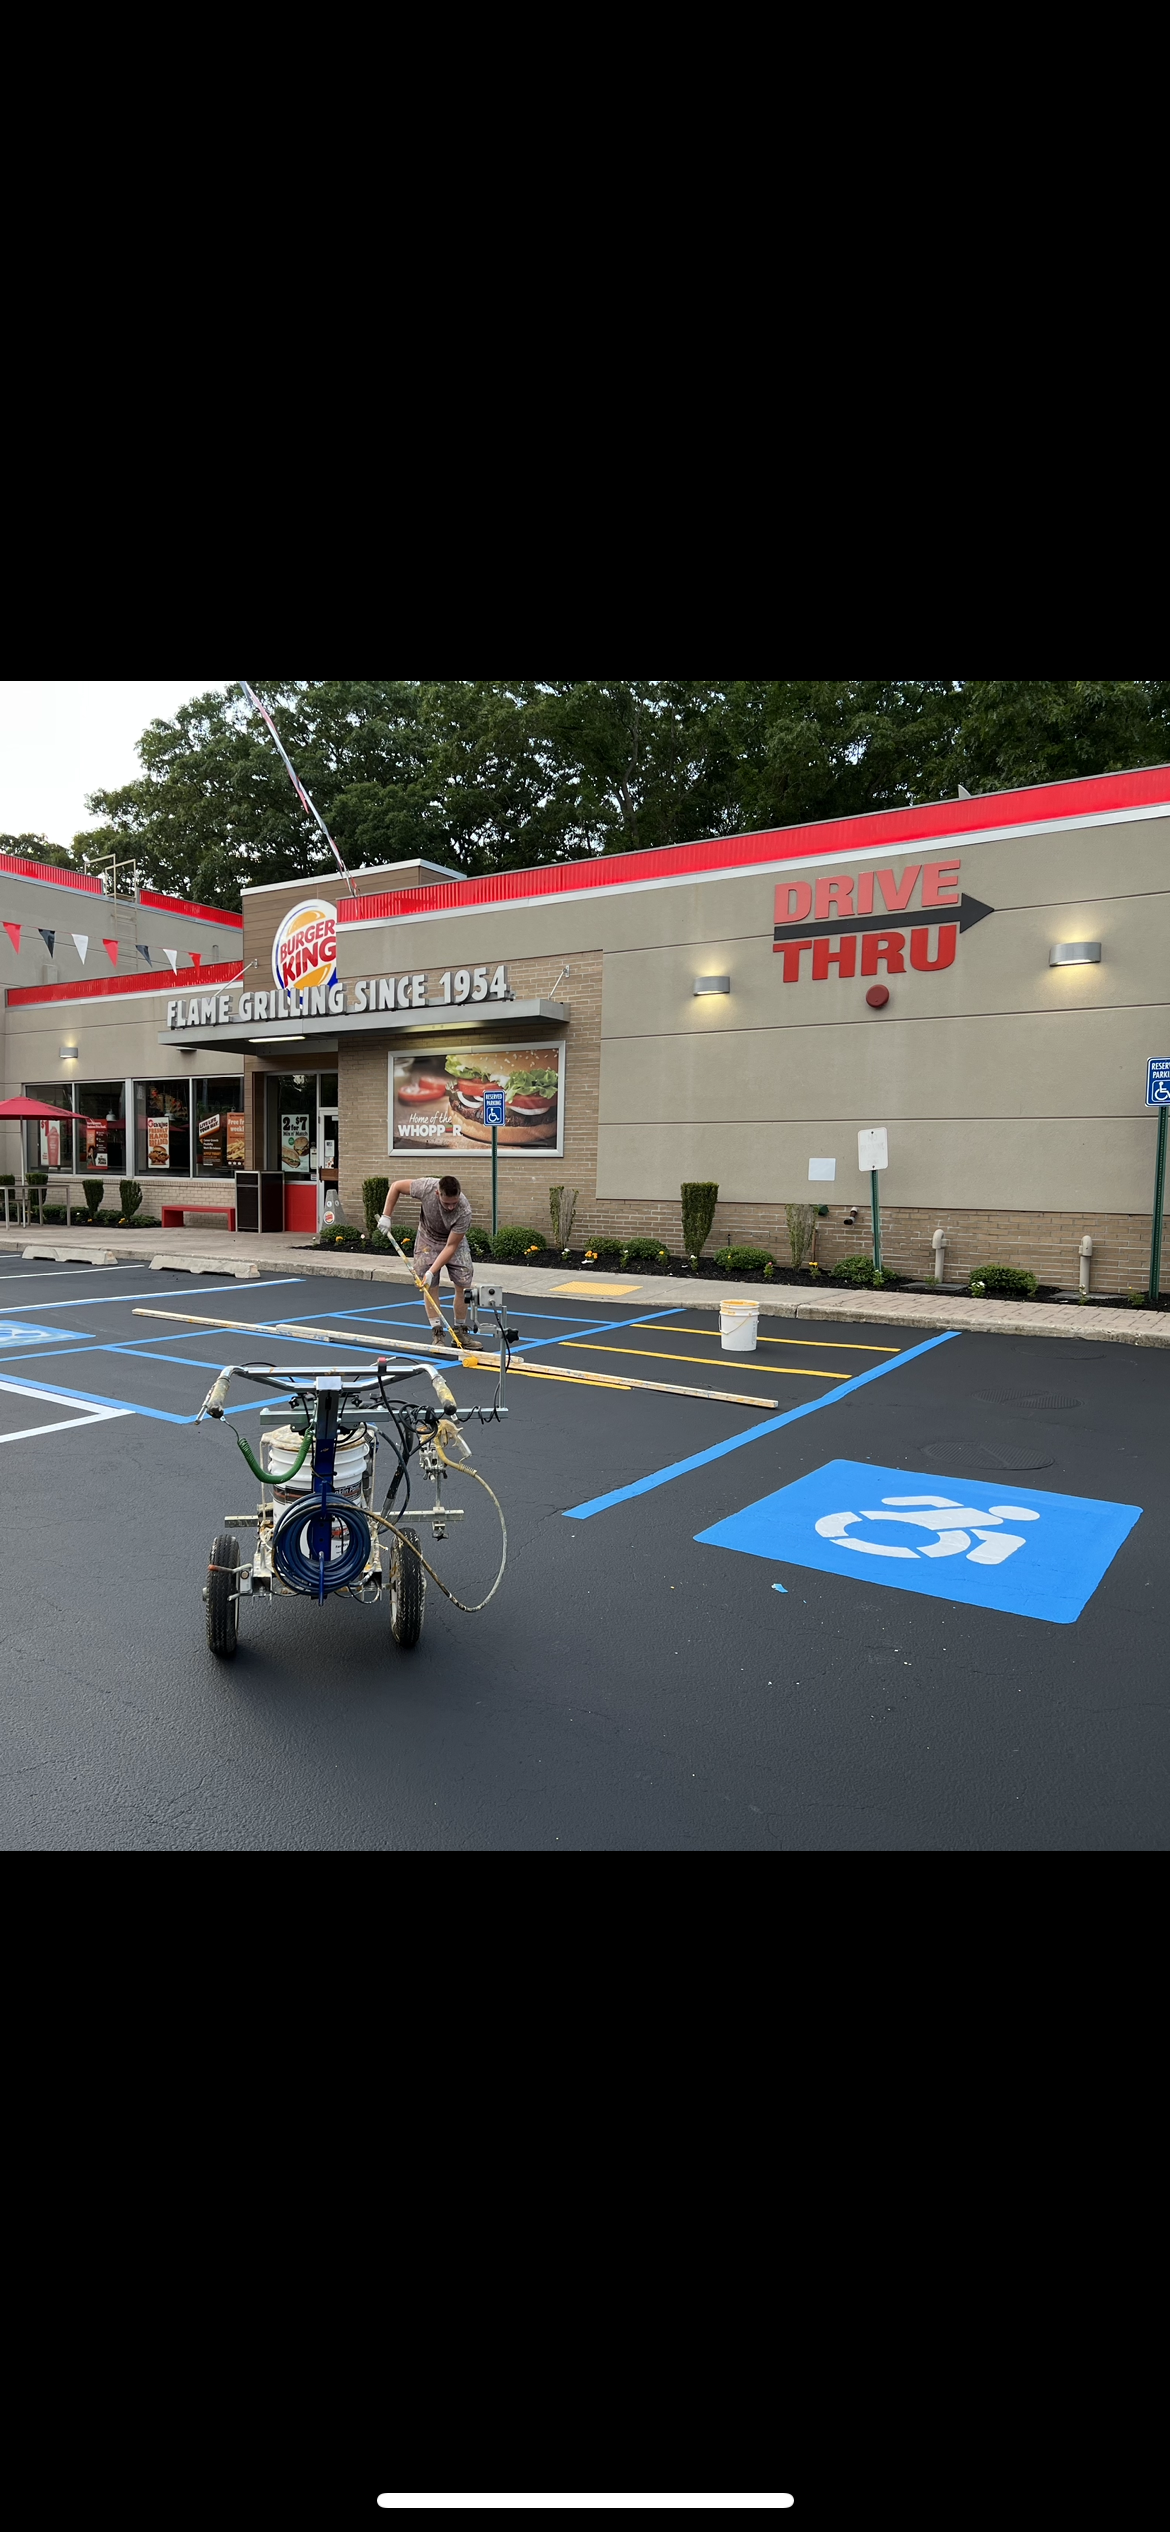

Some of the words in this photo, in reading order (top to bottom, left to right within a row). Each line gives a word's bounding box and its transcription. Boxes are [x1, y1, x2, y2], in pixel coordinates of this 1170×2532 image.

[773, 859, 961, 924] DRIVE
[280, 920, 336, 957] BURGER
[281, 936, 337, 989] KING
[772, 924, 957, 983] THRU
[167, 995, 233, 1029] FLAME
[238, 982, 347, 1021] GRILLING
[355, 974, 430, 1011] SINCE
[438, 965, 511, 1004] 1954
[283, 1116, 290, 1130] 2
[296, 1116, 308, 1130] $7
[409, 1113, 429, 1124] Home
[430, 1111, 439, 1125] of
[439, 1111, 452, 1123] the
